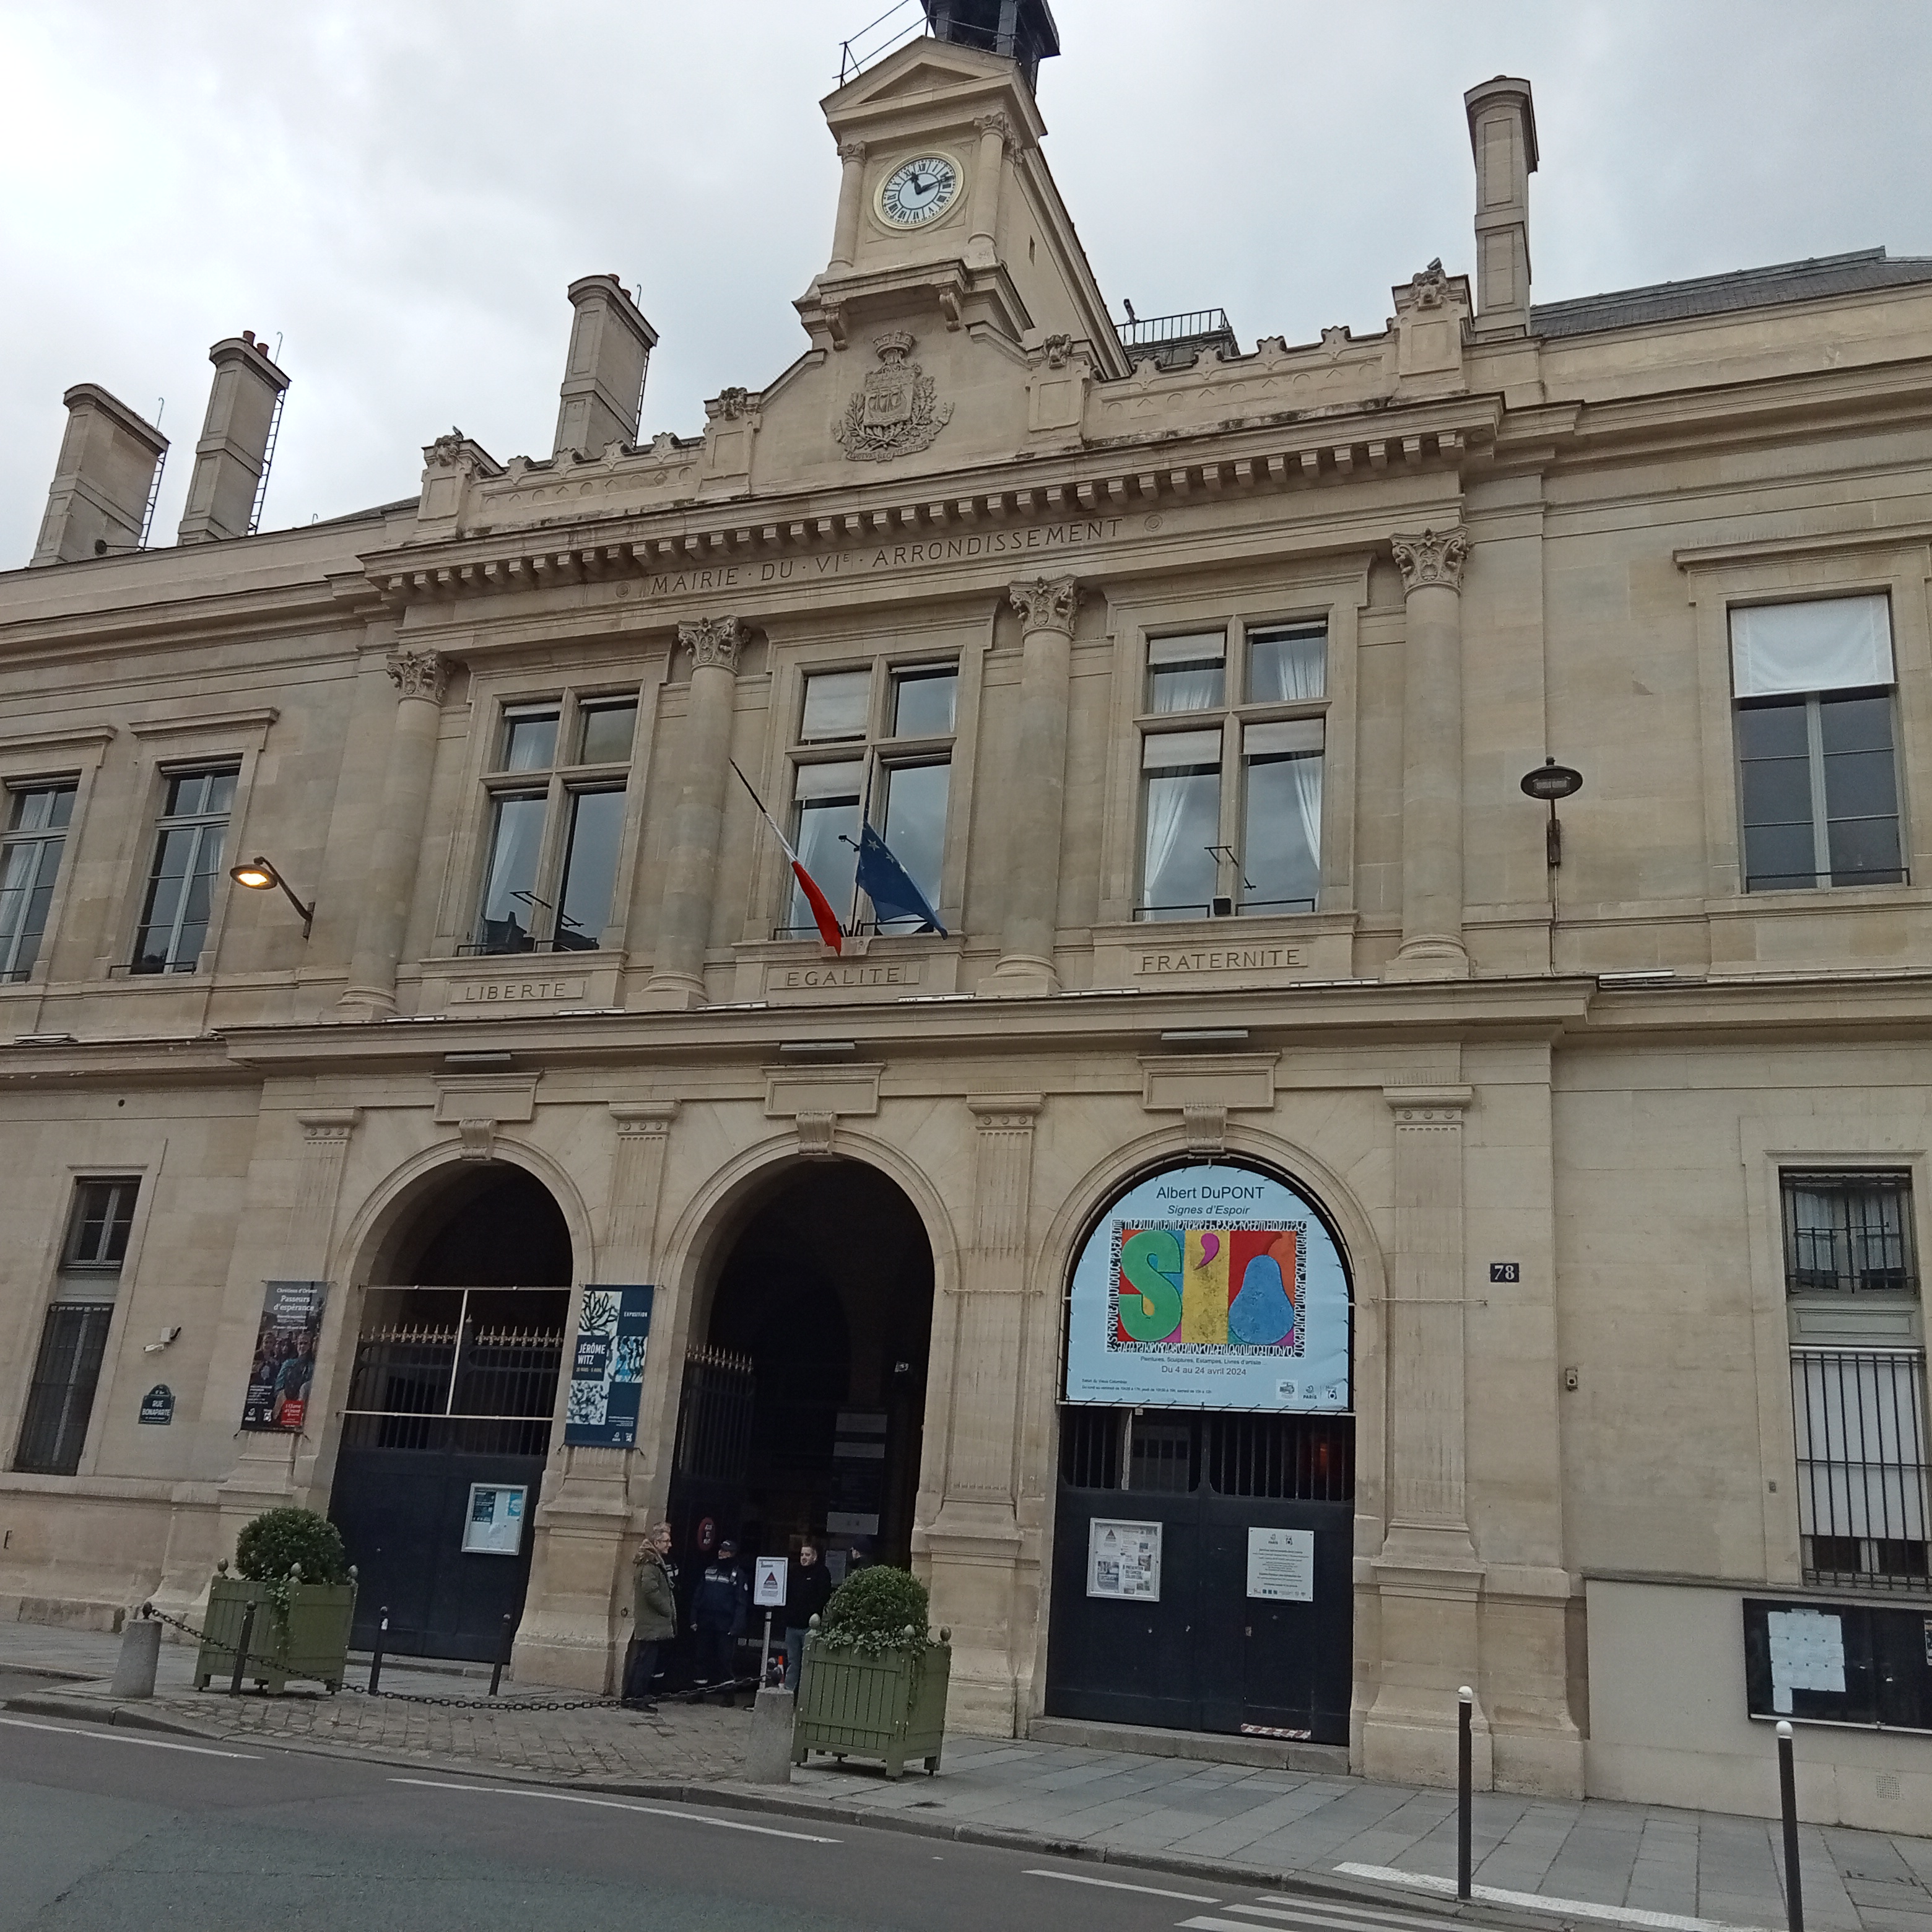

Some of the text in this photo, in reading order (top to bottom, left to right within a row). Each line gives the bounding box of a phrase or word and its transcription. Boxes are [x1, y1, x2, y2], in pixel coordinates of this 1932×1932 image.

[651, 568, 739, 595] MAIRIE
[760, 561, 793, 581] DU
[871, 518, 1123, 567] ARRONDISSEMENT
[1141, 949, 1300, 972] FRATERNITE
[786, 967, 900, 987] EGALITE
[465, 983, 566, 1001] LIBERTE
[1156, 1186, 1265, 1199] Albert DuPONT
[1167, 1205, 1250, 1216] Signes d'Espoir
[1494, 1265, 1515, 1280] 78
[273, 1303, 315, 1313] d'espérance
[578, 1342, 606, 1354] JÉRÔME
[578, 1355, 594, 1365] WITZ
[141, 1408, 172, 1416] BONAPARTE
